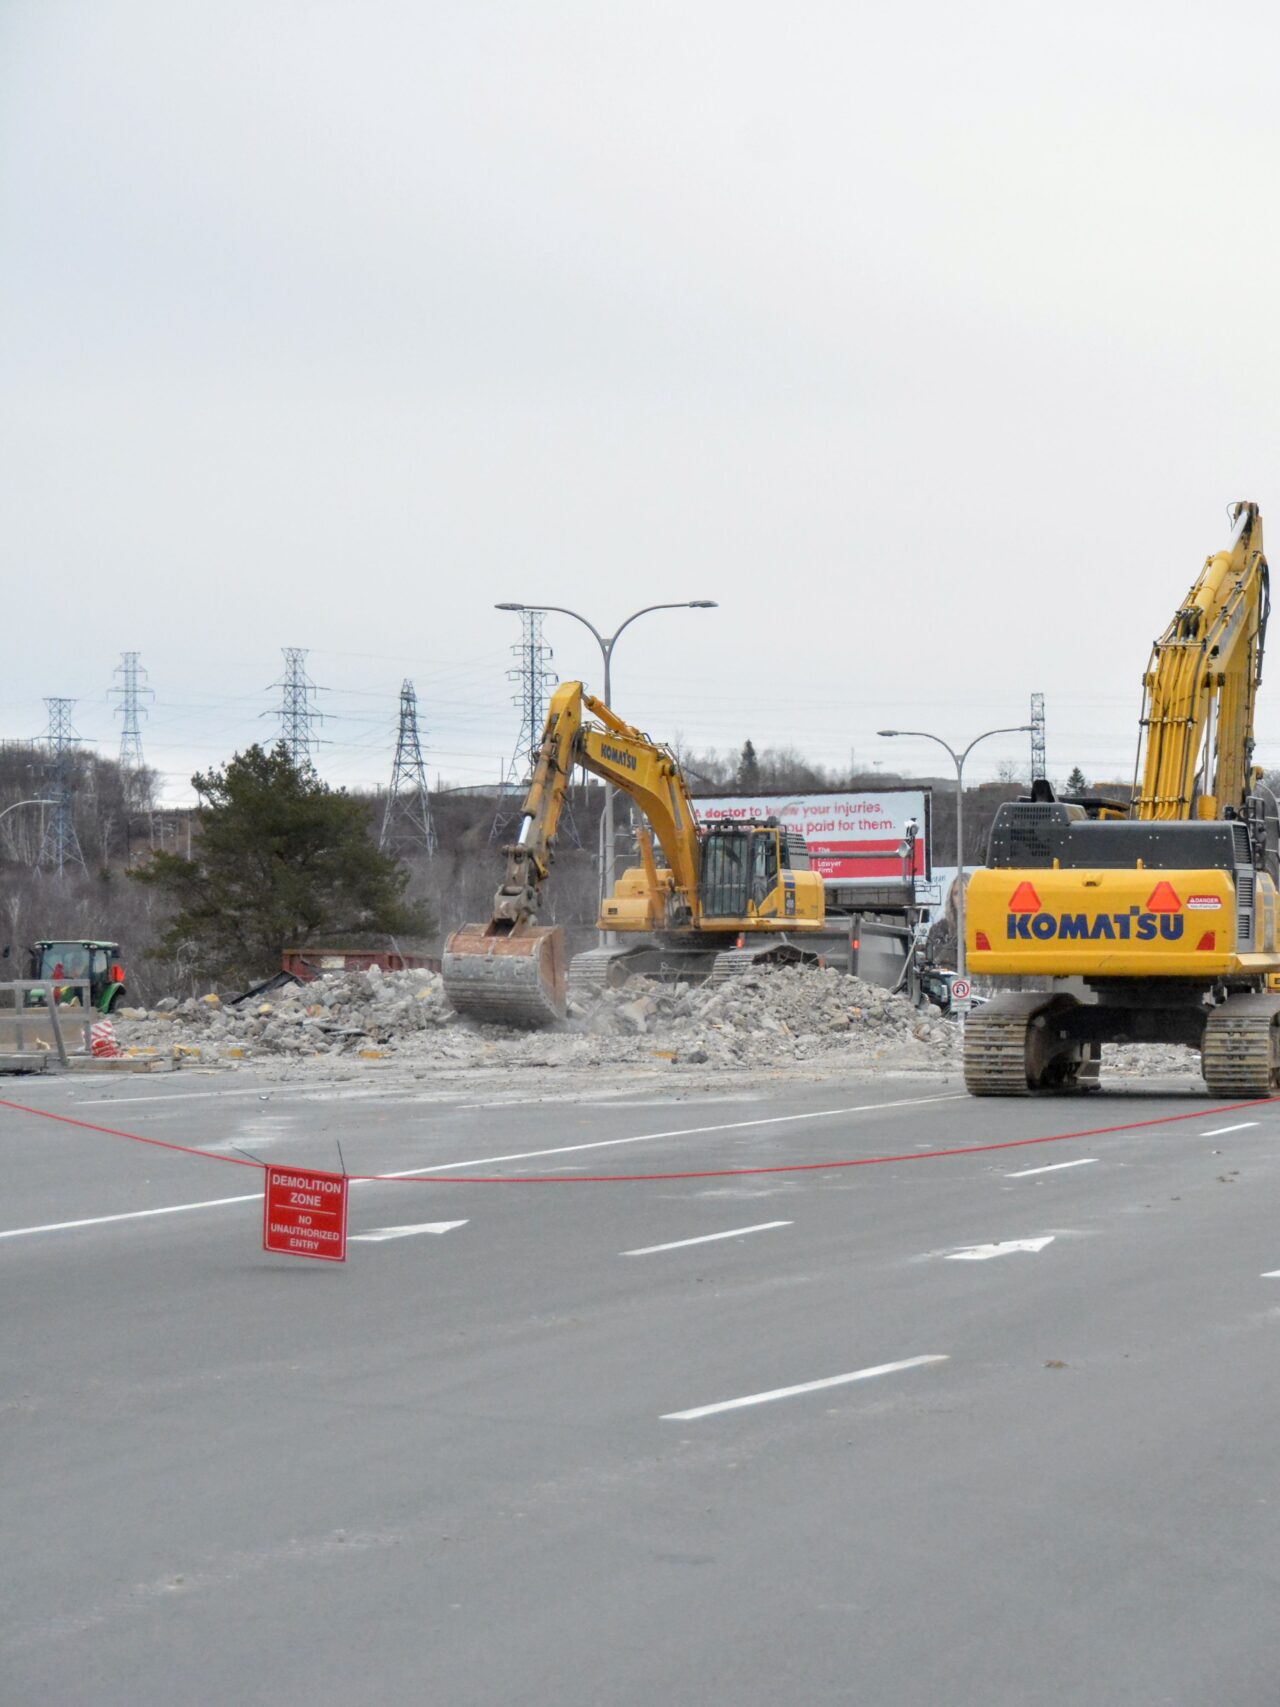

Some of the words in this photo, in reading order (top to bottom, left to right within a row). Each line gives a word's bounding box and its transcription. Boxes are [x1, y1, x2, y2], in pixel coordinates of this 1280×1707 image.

[601, 743, 637, 770] KOMATSU
[705, 808, 746, 818] doctor
[749, 806, 761, 817] to
[803, 805, 831, 818] your
[806, 820, 835, 836] paid
[838, 819, 856, 831] for
[858, 818, 896, 830] them.
[818, 860, 842, 868] Lawyer
[1007, 906, 1183, 940] KOMATSU
[272, 1174, 341, 1193] DEMOLITION
[290, 1192, 322, 1206] ZONE
[298, 1215, 312, 1224] NO
[270, 1223, 339, 1240] UNAUTHORIZED
[289, 1237, 319, 1250] ENTRY
